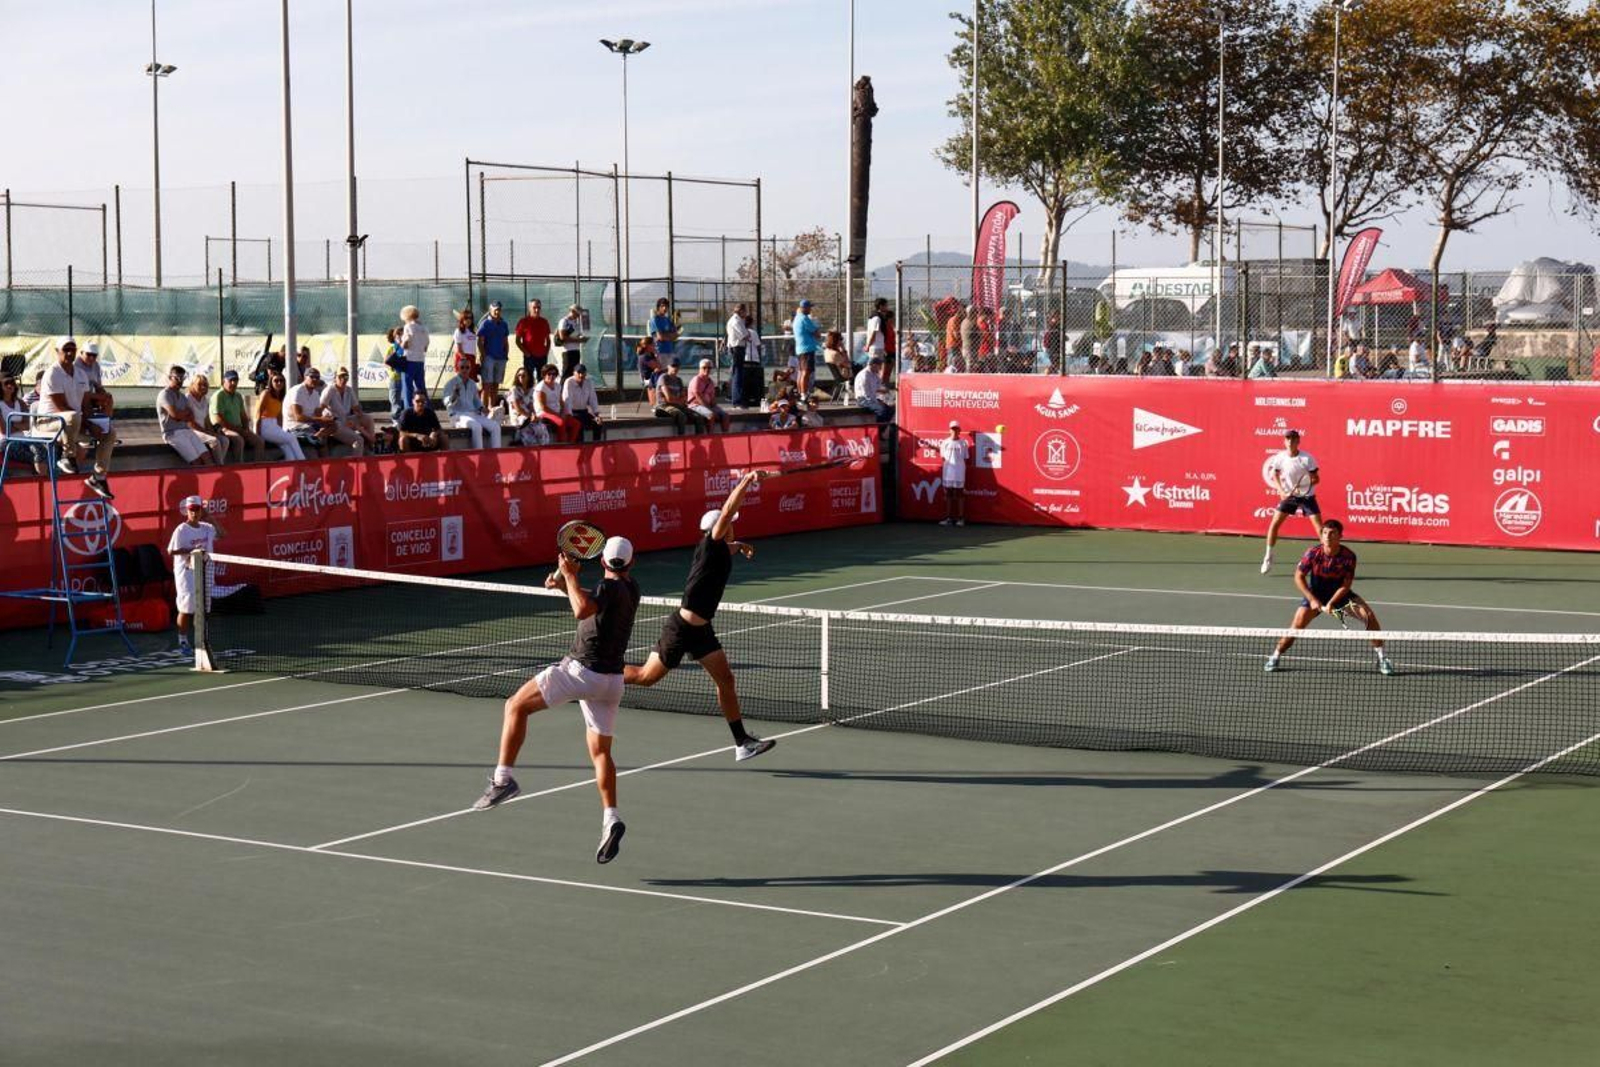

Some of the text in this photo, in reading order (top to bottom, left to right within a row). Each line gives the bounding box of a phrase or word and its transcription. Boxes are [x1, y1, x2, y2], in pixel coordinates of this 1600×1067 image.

[944, 389, 999, 400] DEPUTACIÓN
[943, 399, 1000, 409] PONTEVEDRA
[1034, 403, 1080, 419] AGUA SANA
[1346, 419, 1451, 438] MAPFRE
[1493, 418, 1542, 433] GADIS
[923, 449, 937, 458] DE
[1493, 466, 1541, 486] galpi
[1152, 481, 1210, 501] Estrella
[1168, 500, 1194, 509] Damm
[1348, 514, 1450, 527] www.interrias.com
[391, 528, 437, 543] CONCELLO
[273, 539, 323, 555] CONCELLO
[396, 542, 432, 556] DE VIGO
